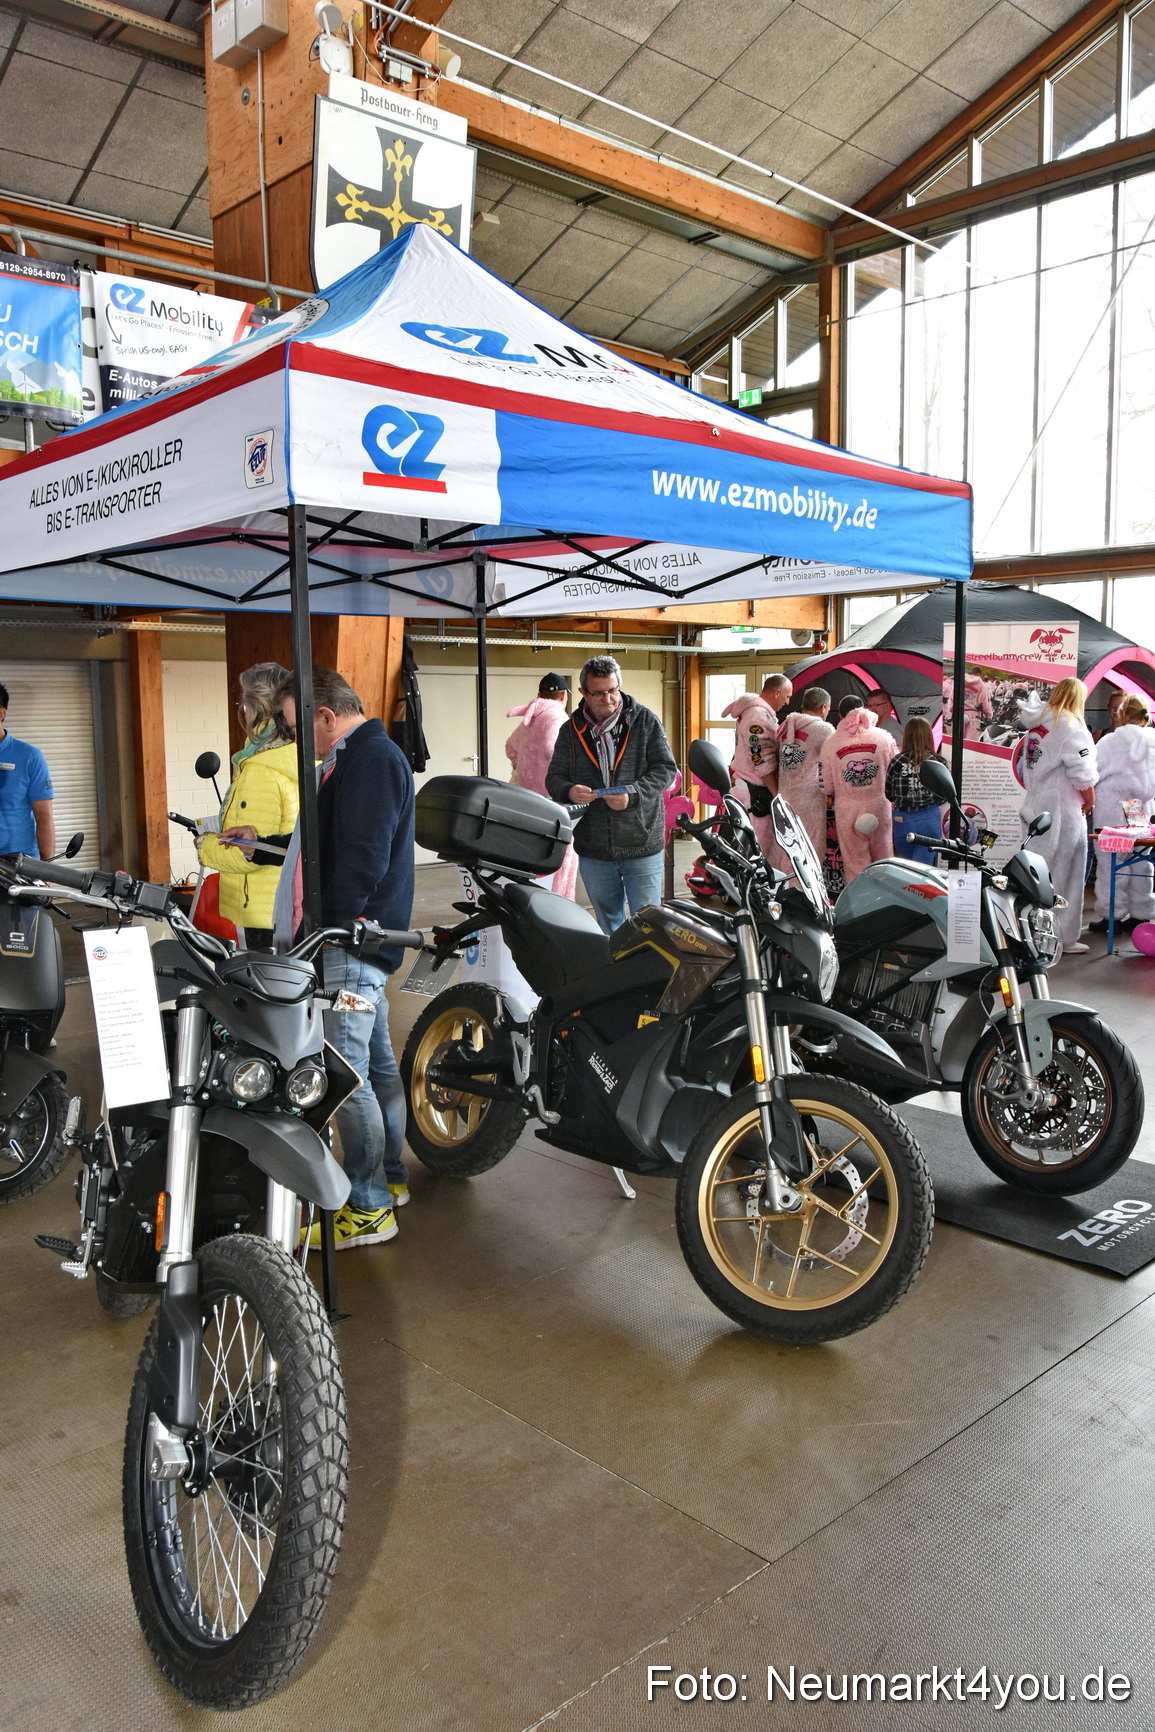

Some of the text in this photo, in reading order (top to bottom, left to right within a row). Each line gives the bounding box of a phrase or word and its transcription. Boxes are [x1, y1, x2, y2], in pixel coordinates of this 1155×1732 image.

[360, 86, 438, 131] Postbauer-Heng
[129, 316, 140, 325] Go
[140, 318, 164, 331] Places!
[169, 326, 198, 337] Emission
[198, 330, 215, 342] Free.
[150, 300, 224, 337] Mobility
[169, 344, 188, 354] EASY
[109, 369, 158, 389] E-Autos
[508, 364, 542, 378] Go
[544, 369, 621, 385] Places!
[29, 438, 183, 509] ALLES VON E-(KICK)ROLLER
[46, 481, 162, 534] BIS E-TRANSPORTER
[651, 469, 878, 532] www.ezmobility.de
[668, 921, 697, 944] ZERO
[1056, 1199, 1153, 1247] ZERO
